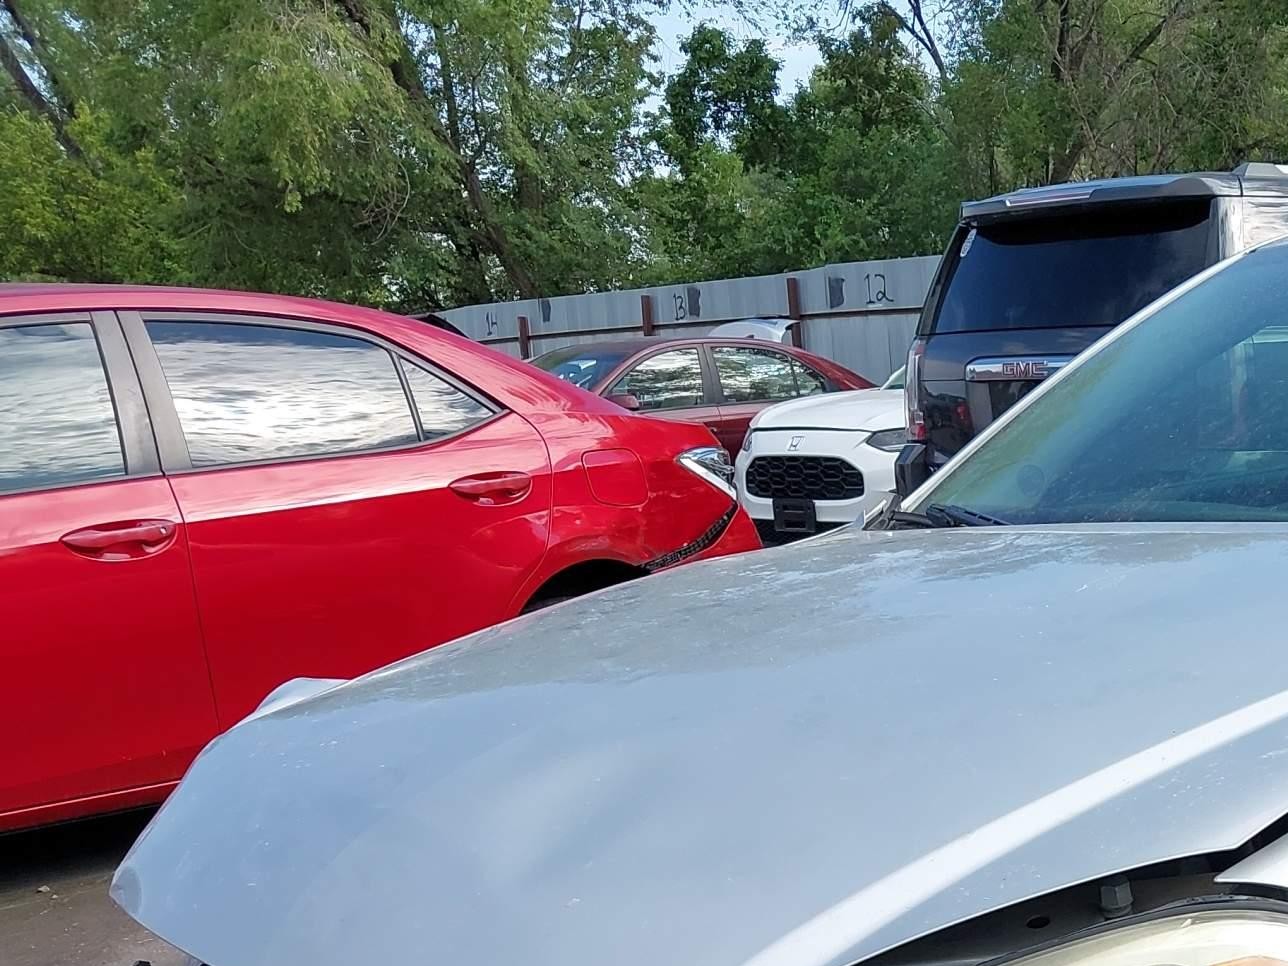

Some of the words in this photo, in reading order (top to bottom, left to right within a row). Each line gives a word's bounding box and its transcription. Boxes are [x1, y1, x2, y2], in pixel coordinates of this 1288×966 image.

[864, 273, 894, 304] 12
[673, 292, 686, 321] 13
[1002, 361, 1049, 377] GMC
